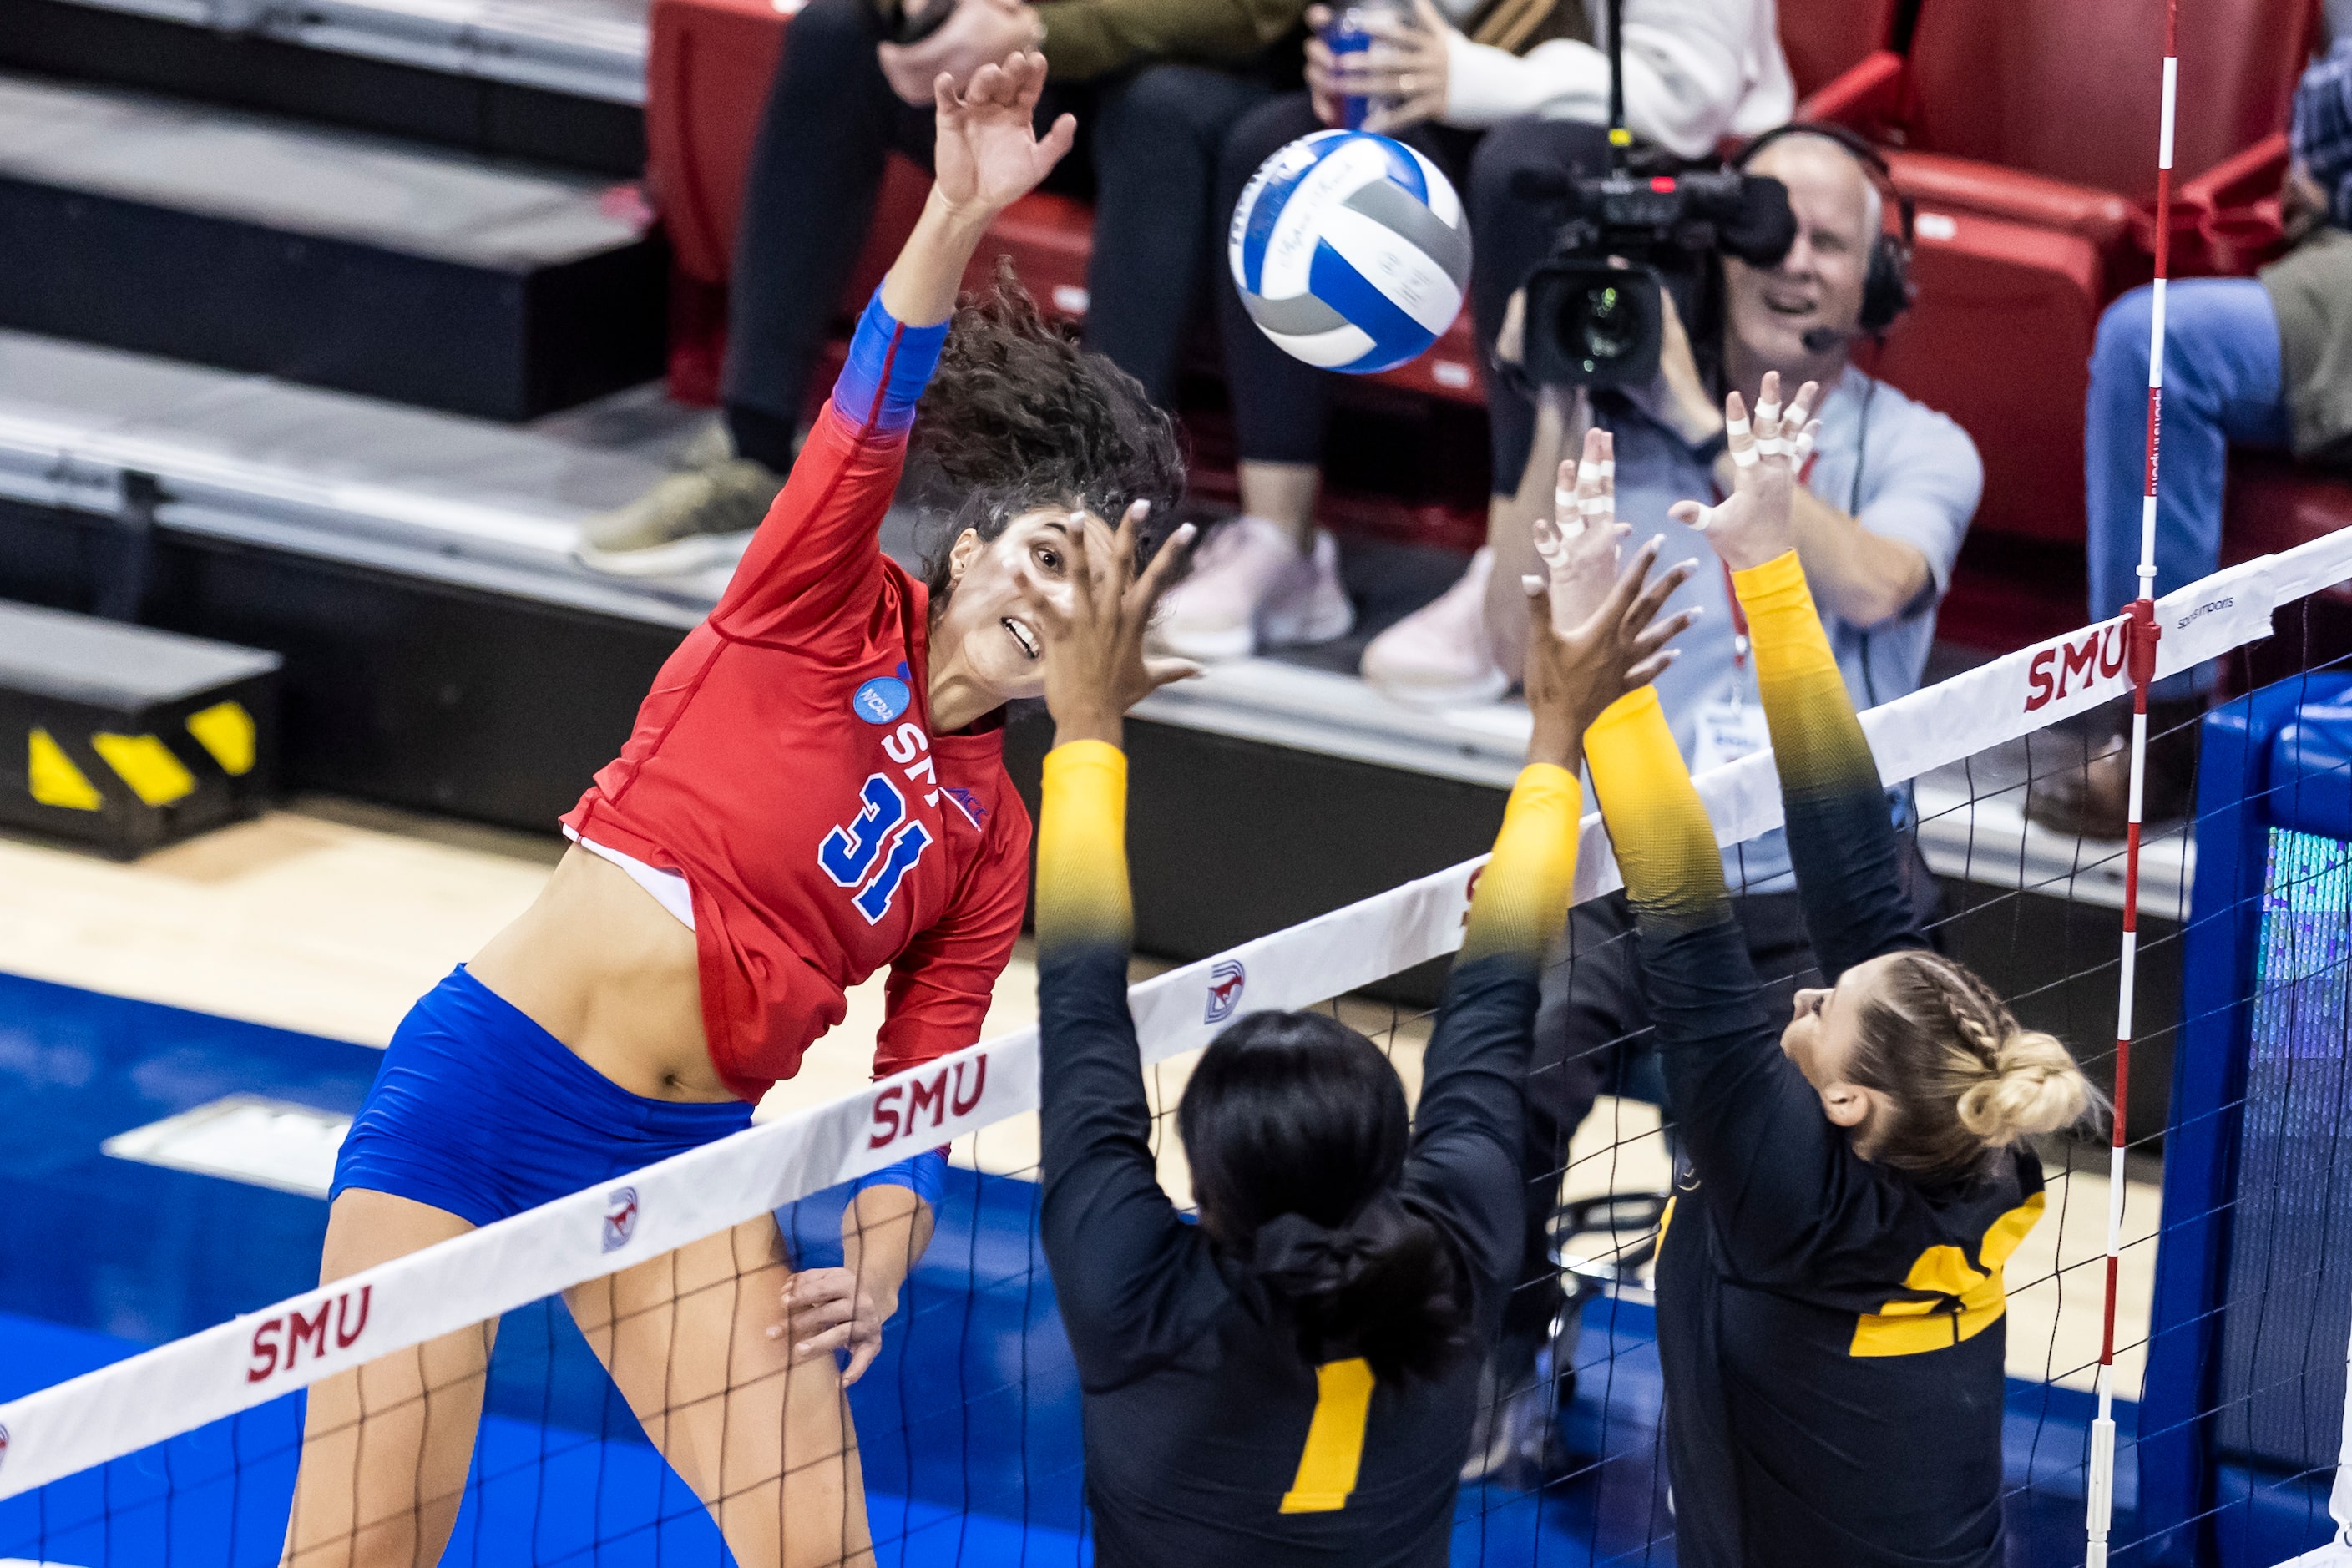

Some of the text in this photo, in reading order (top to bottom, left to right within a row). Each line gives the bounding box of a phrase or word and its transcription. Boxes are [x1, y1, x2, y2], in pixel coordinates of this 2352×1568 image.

[860, 687, 893, 722] NCAA
[2023, 620, 2135, 713] SMU
[817, 772, 934, 927] 31
[942, 788, 989, 827] ACC
[867, 1053, 988, 1151] SMU
[247, 1283, 372, 1383] SMU
[1278, 1356, 1376, 1515] 1
